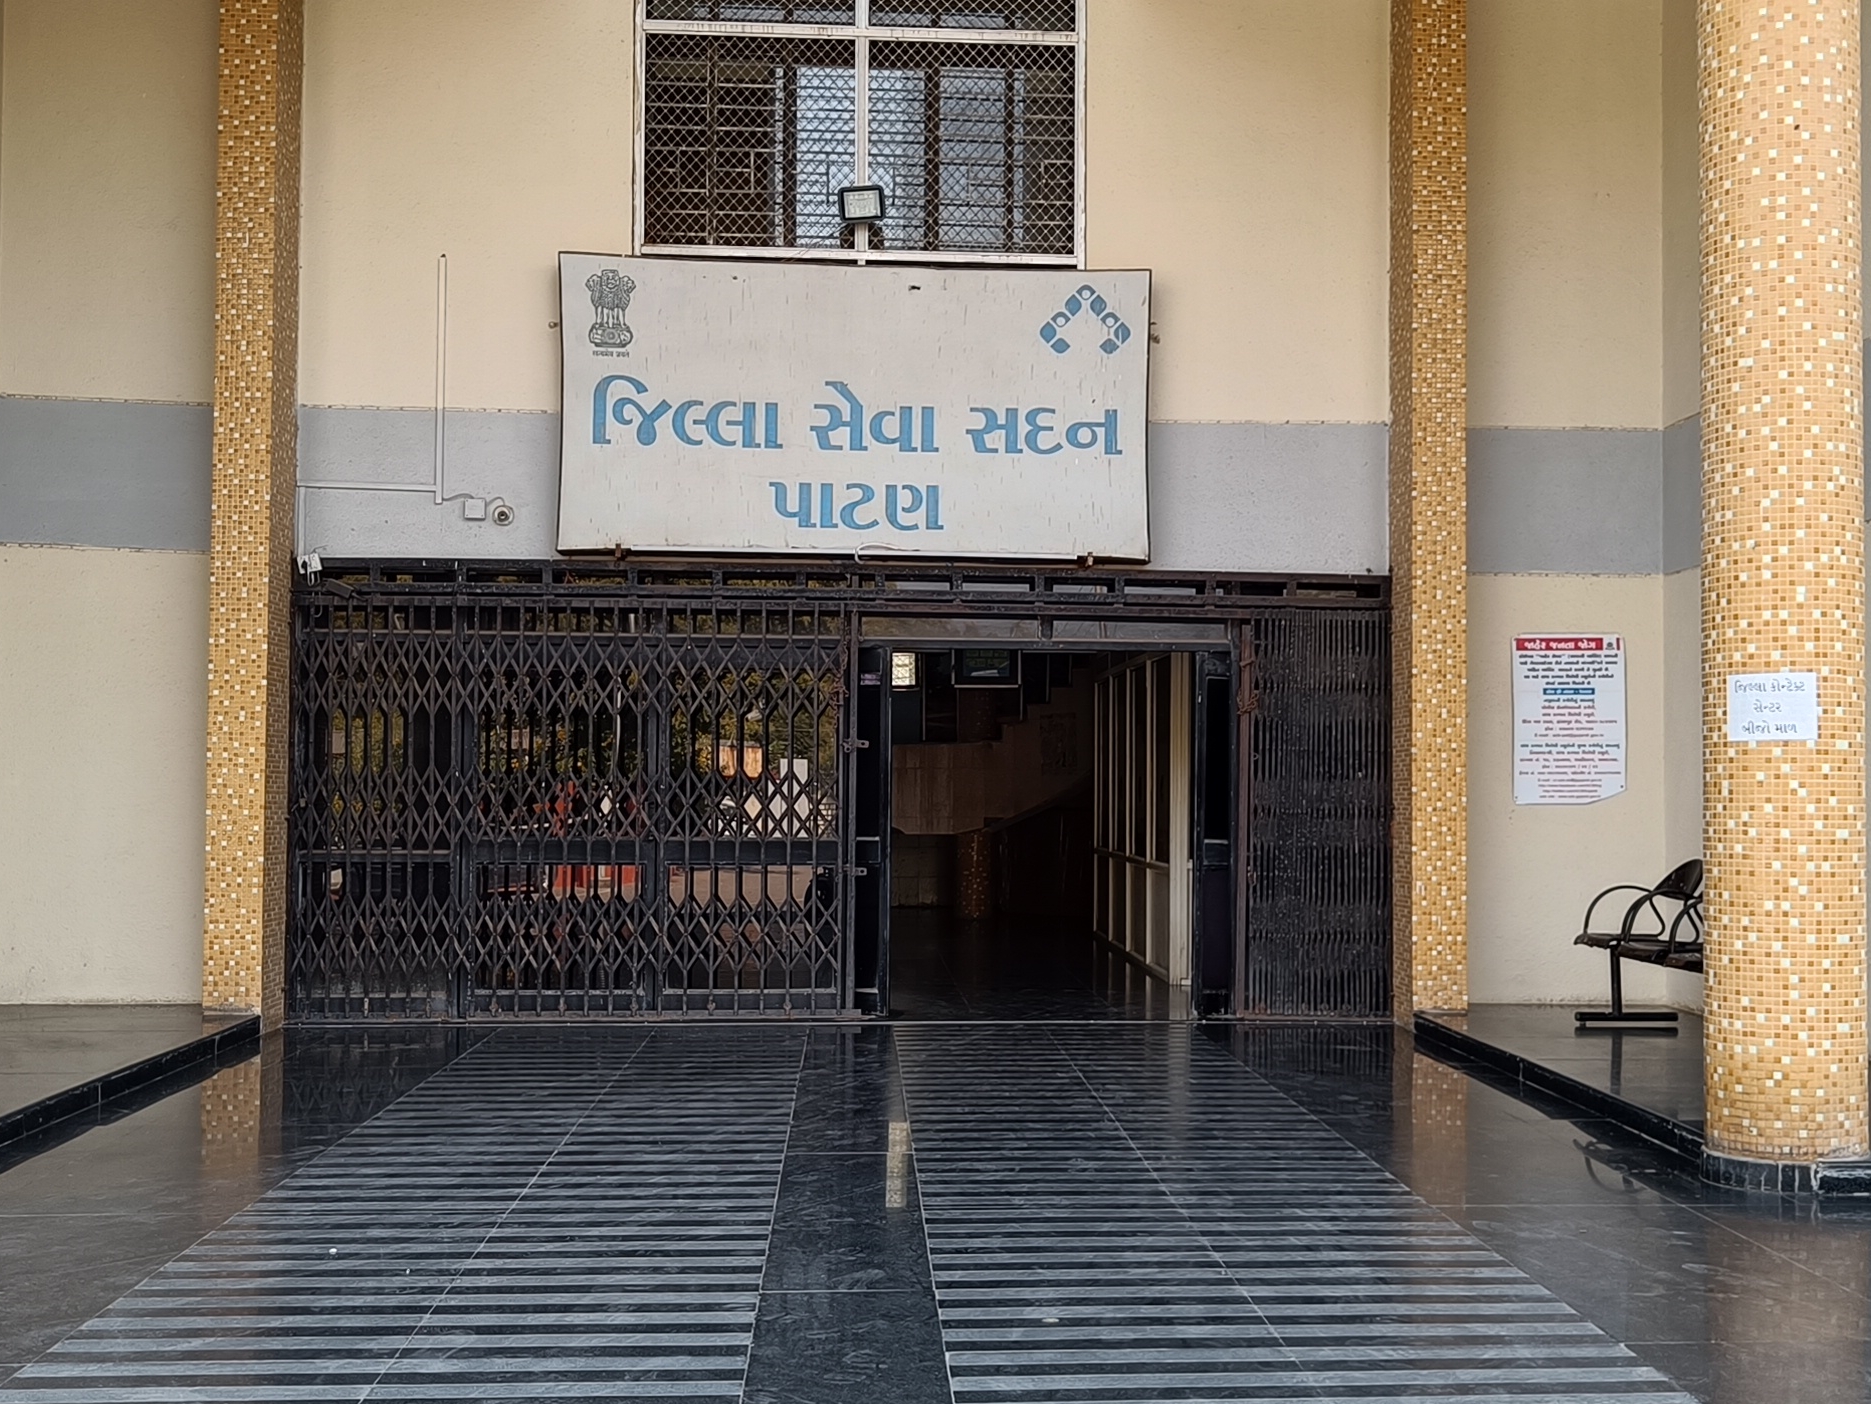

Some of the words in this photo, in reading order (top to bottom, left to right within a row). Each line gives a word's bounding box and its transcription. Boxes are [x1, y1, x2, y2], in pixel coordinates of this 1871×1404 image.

[592, 374, 784, 450] જિલ્લા
[809, 381, 940, 453] સેવા
[965, 406, 1124, 456] સદન
[768, 481, 946, 532] પાટણ
[1524, 639, 1547, 650] જાહેર
[1549, 640, 1575, 650] જનતા
[1734, 679, 1767, 693] જિલ્લા
[1753, 699, 1782, 713] સેન્ટર
[1741, 720, 1771, 734] બીજો
[1774, 723, 1798, 734] માળ
